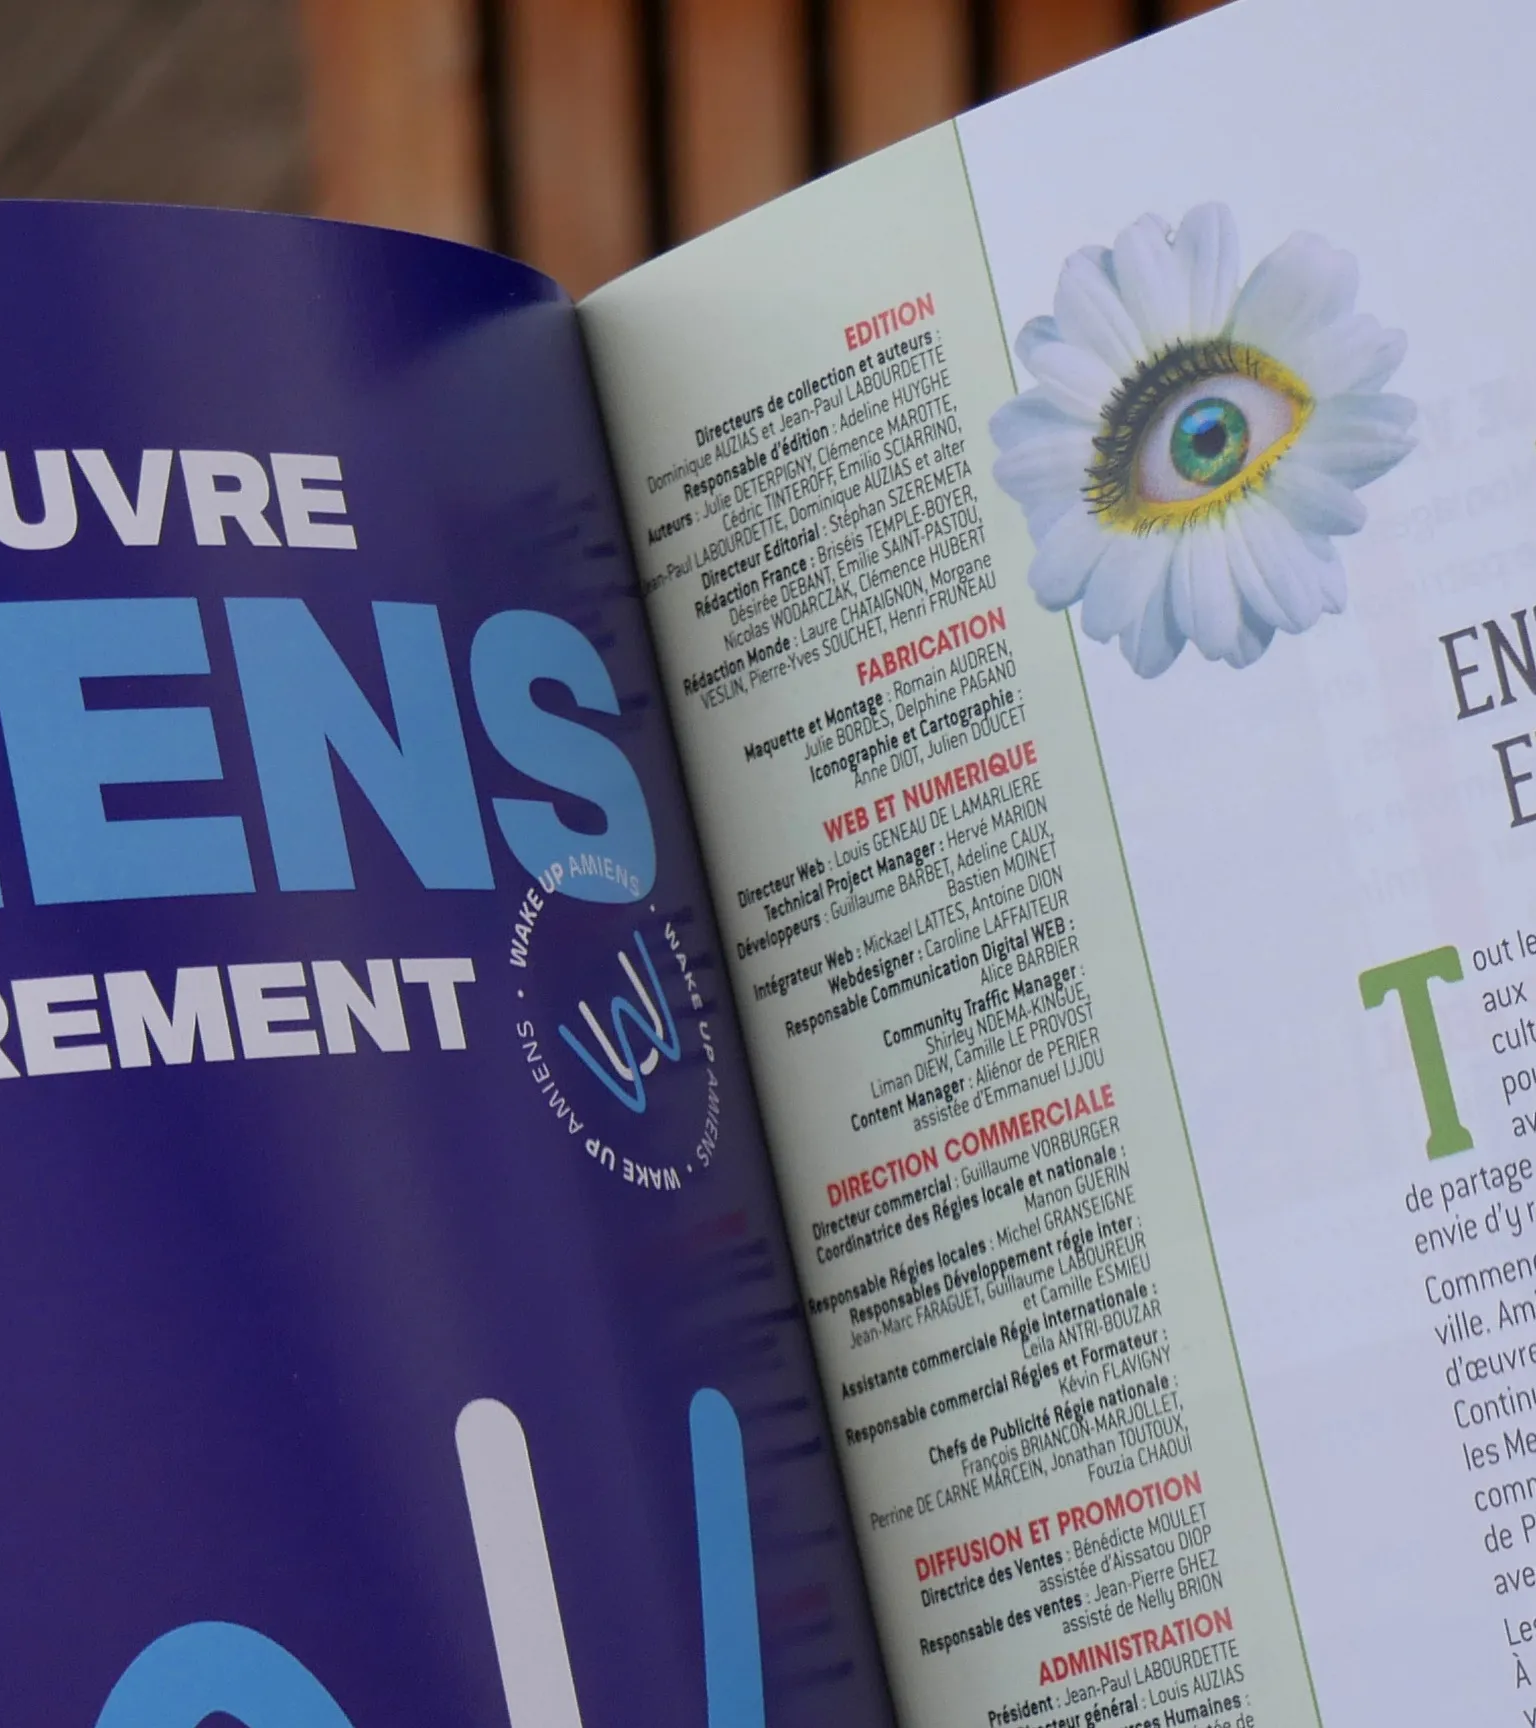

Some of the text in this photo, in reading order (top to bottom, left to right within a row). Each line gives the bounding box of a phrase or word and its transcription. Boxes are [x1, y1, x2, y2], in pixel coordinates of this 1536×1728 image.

[844, 293, 936, 352] EDITION
[856, 607, 1008, 686] FABRICATION
[803, 658, 1017, 761] Julie BORDES, Delphine PAGANO
[823, 740, 1039, 842] WEB ET NUMERIQUE
[510, 853, 640, 968] WAKE UP AMIENS
[980, 934, 1081, 987] Alice BARBIER
[1481, 981, 1528, 1014] aux
[516, 1020, 682, 1191] WAKE UP AMIENS
[825, 1083, 1116, 1208] DIRECTION COMMERCIALE
[1057, 1343, 1171, 1398] Kévin FLAVIGNY
[913, 1471, 1204, 1583] DIFFUSION ET PROMOTION
[1038, 1523, 1212, 1594] assistée d'Aissatou DIOP
[1061, 1570, 1224, 1635] assisté de Nelly BRION
[1039, 1609, 1234, 1687] ADMINISTRATION
